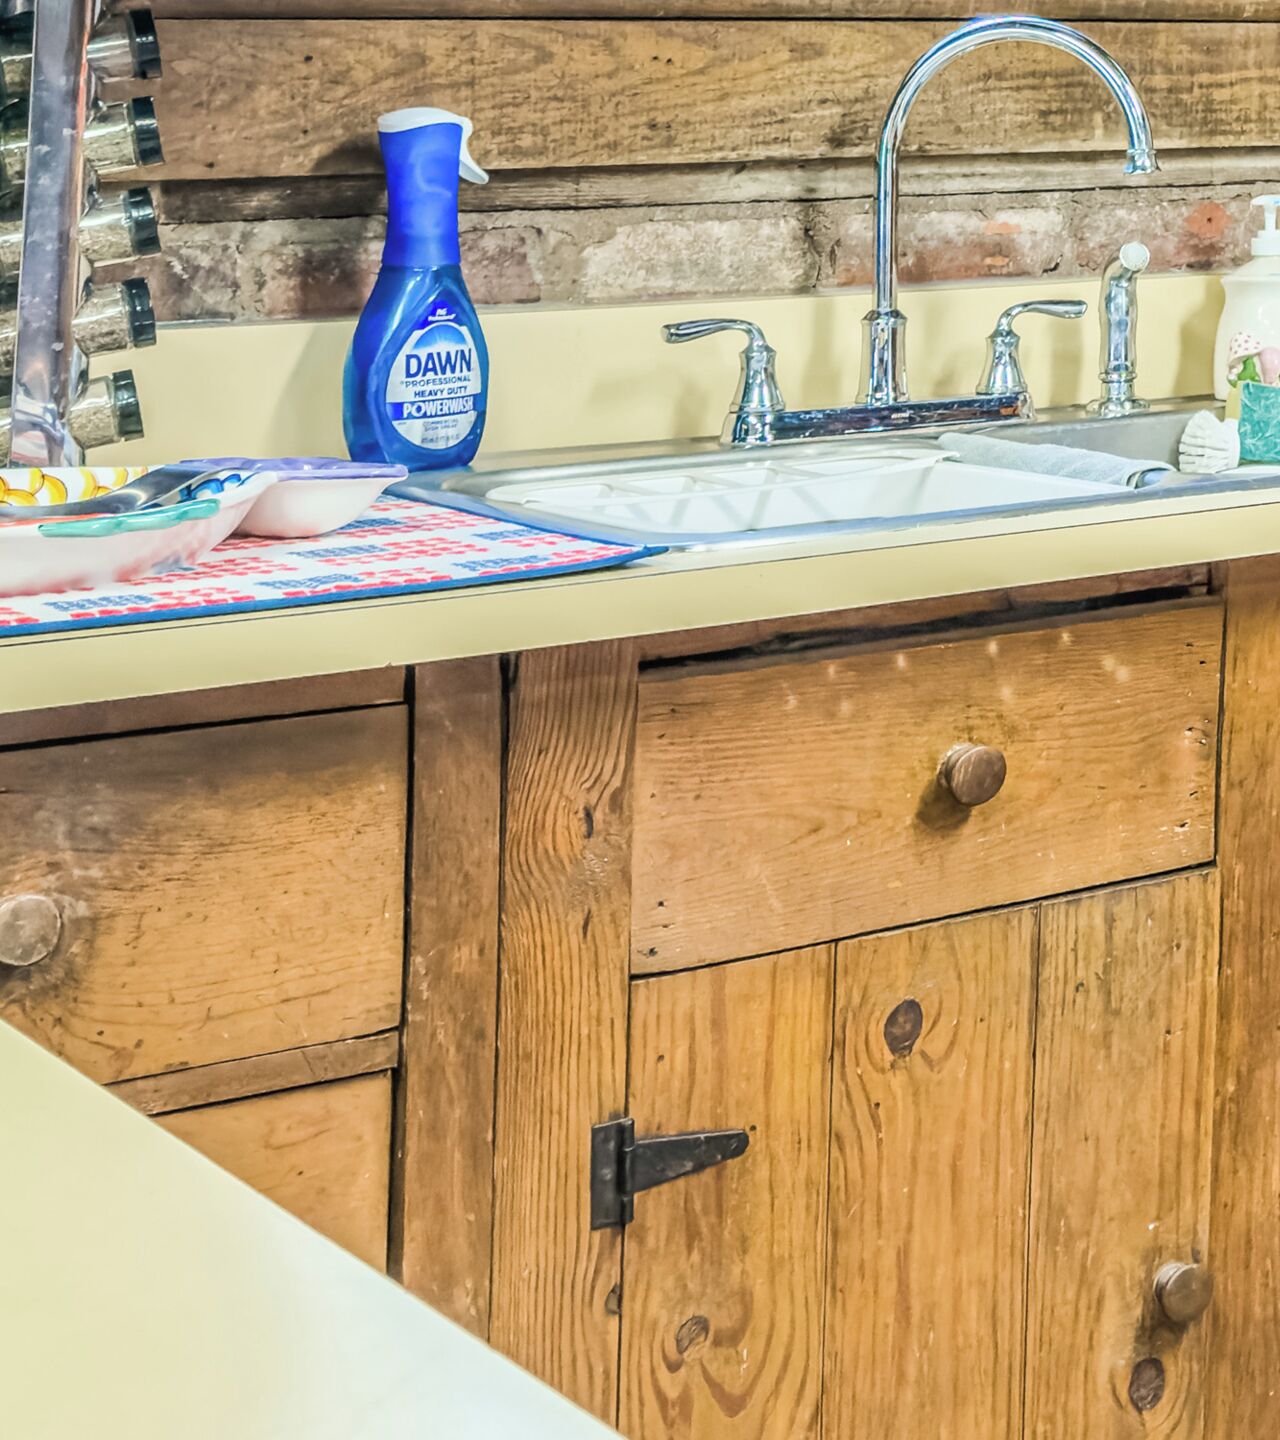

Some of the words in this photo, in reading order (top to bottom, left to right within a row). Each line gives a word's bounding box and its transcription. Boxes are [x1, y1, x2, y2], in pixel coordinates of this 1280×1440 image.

[405, 348, 472, 379] DAWN
[405, 376, 471, 388] PROFESSIONAL
[414, 388, 446, 398] HEAVY
[447, 385, 467, 395] DUTY
[402, 396, 474, 418] POWERWASH
